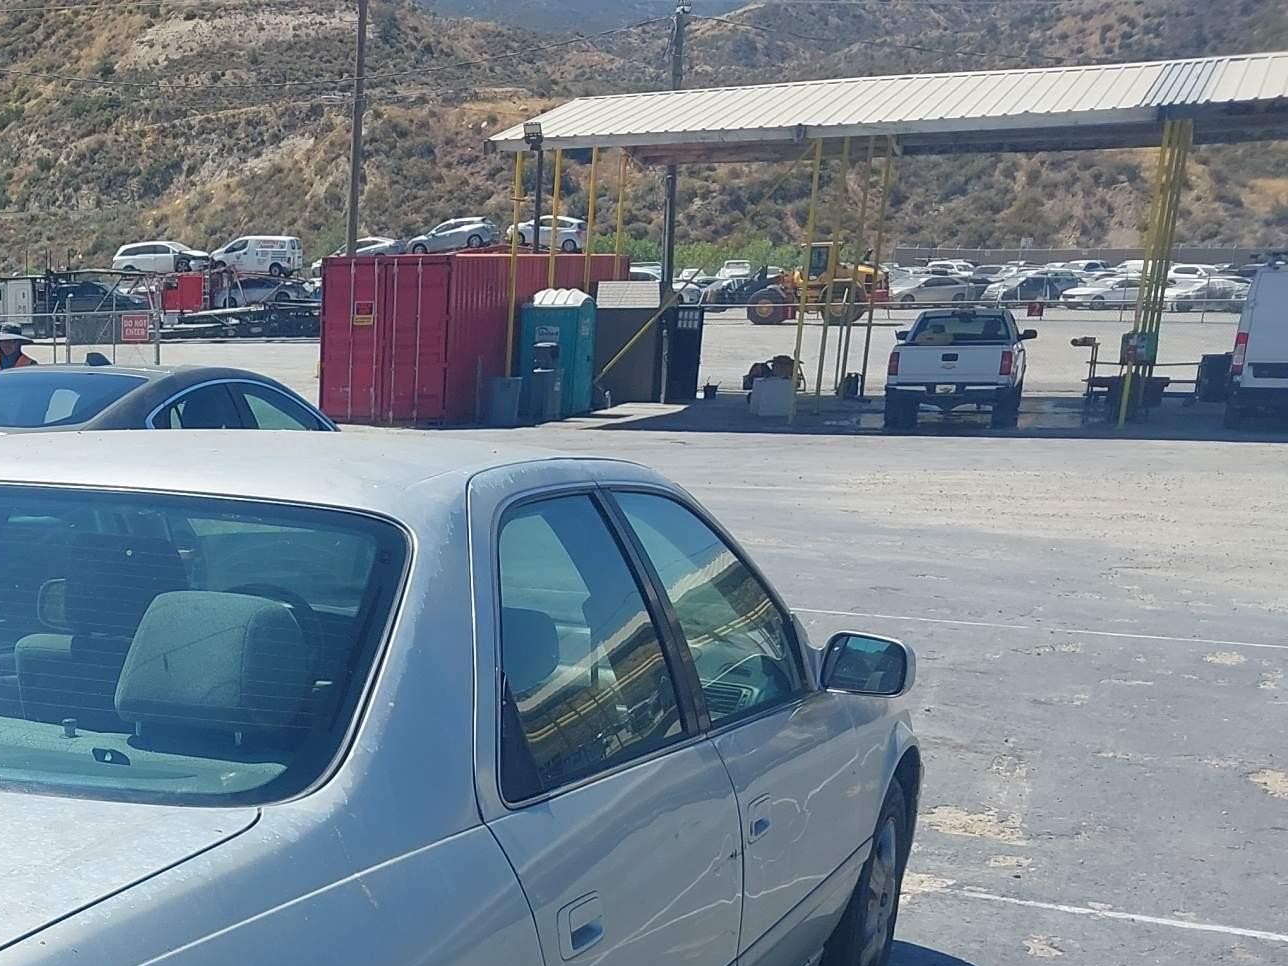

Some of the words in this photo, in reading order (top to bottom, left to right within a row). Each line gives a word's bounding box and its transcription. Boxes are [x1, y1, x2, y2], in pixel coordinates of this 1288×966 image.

[123, 319, 133, 328] DO
[134, 319, 147, 328] NOT
[125, 328, 146, 336] ENTER
